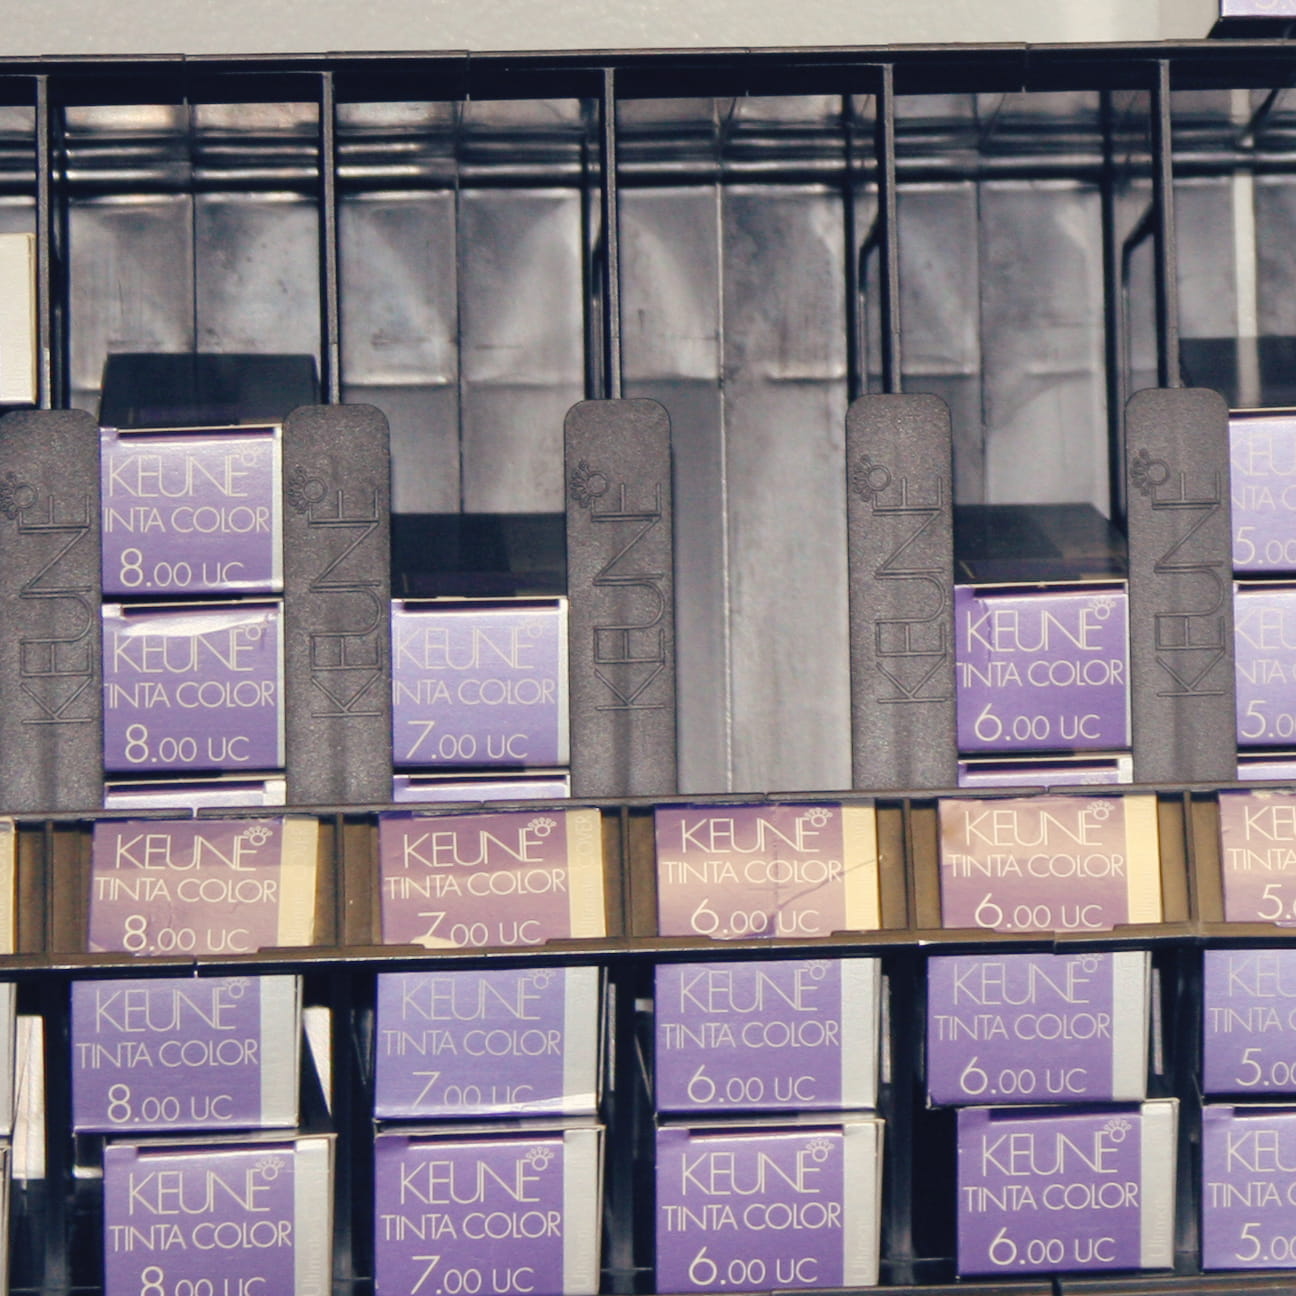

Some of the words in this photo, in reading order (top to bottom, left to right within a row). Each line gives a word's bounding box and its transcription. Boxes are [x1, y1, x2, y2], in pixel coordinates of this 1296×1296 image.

[592, 482, 666, 710] KEUNE
[872, 478, 946, 705] KEUNE
[116, 834, 256, 870] KEUNE
[95, 876, 171, 902] TINTA
[172, 878, 277, 903] COLOR
[122, 914, 197, 952] 8.00
[206, 928, 249, 952] UC
[981, 1134, 1117, 1176] KEUNE
[962, 1185, 1038, 1212] TINTA
[1042, 1182, 1139, 1210] COLOR
[988, 1226, 1064, 1265] 6.00
[1074, 1238, 1114, 1263] UC
